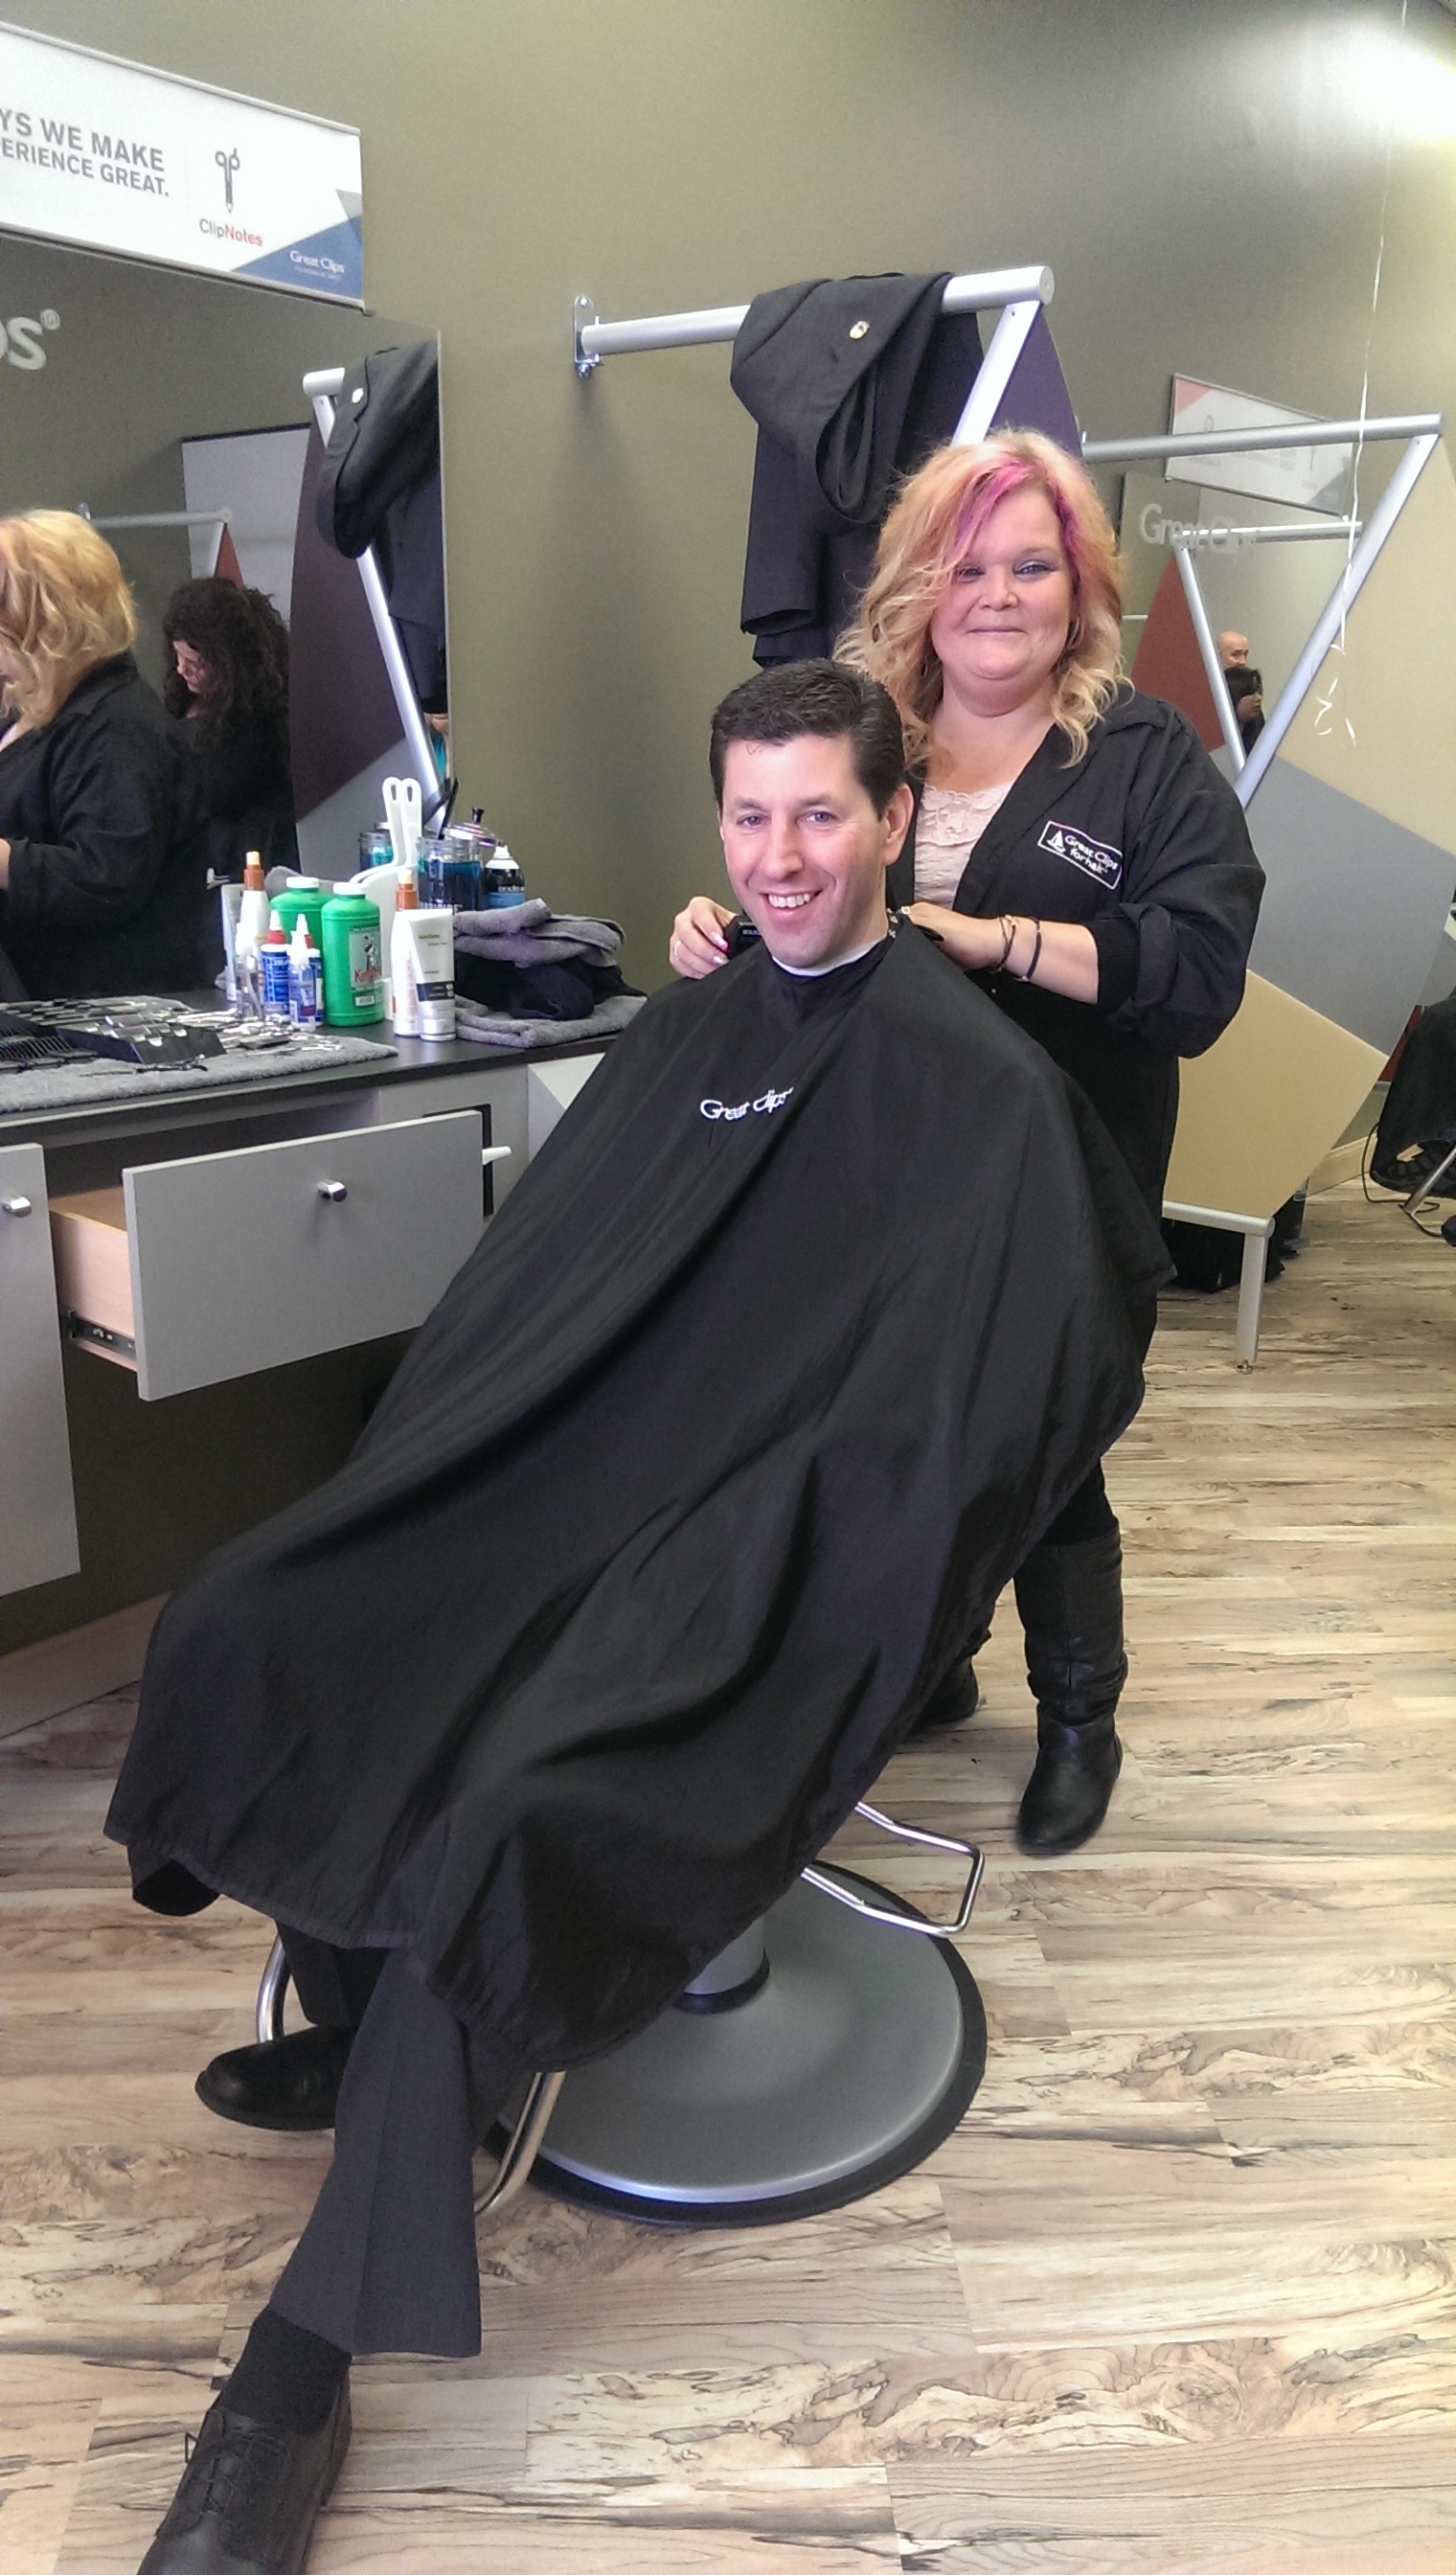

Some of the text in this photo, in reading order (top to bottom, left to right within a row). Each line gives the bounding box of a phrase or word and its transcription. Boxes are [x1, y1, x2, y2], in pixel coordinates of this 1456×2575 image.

[40, 118, 83, 151] WE
[91, 131, 165, 172] MAKE
[0, 137, 170, 197] ERIENCE GREAT.
[199, 217, 263, 246] ClipNotes
[289, 250, 319, 268] Great
[320, 257, 345, 274] Clips
[1064, 835, 1119, 871] Great Clips
[699, 1099, 750, 1121] Great
